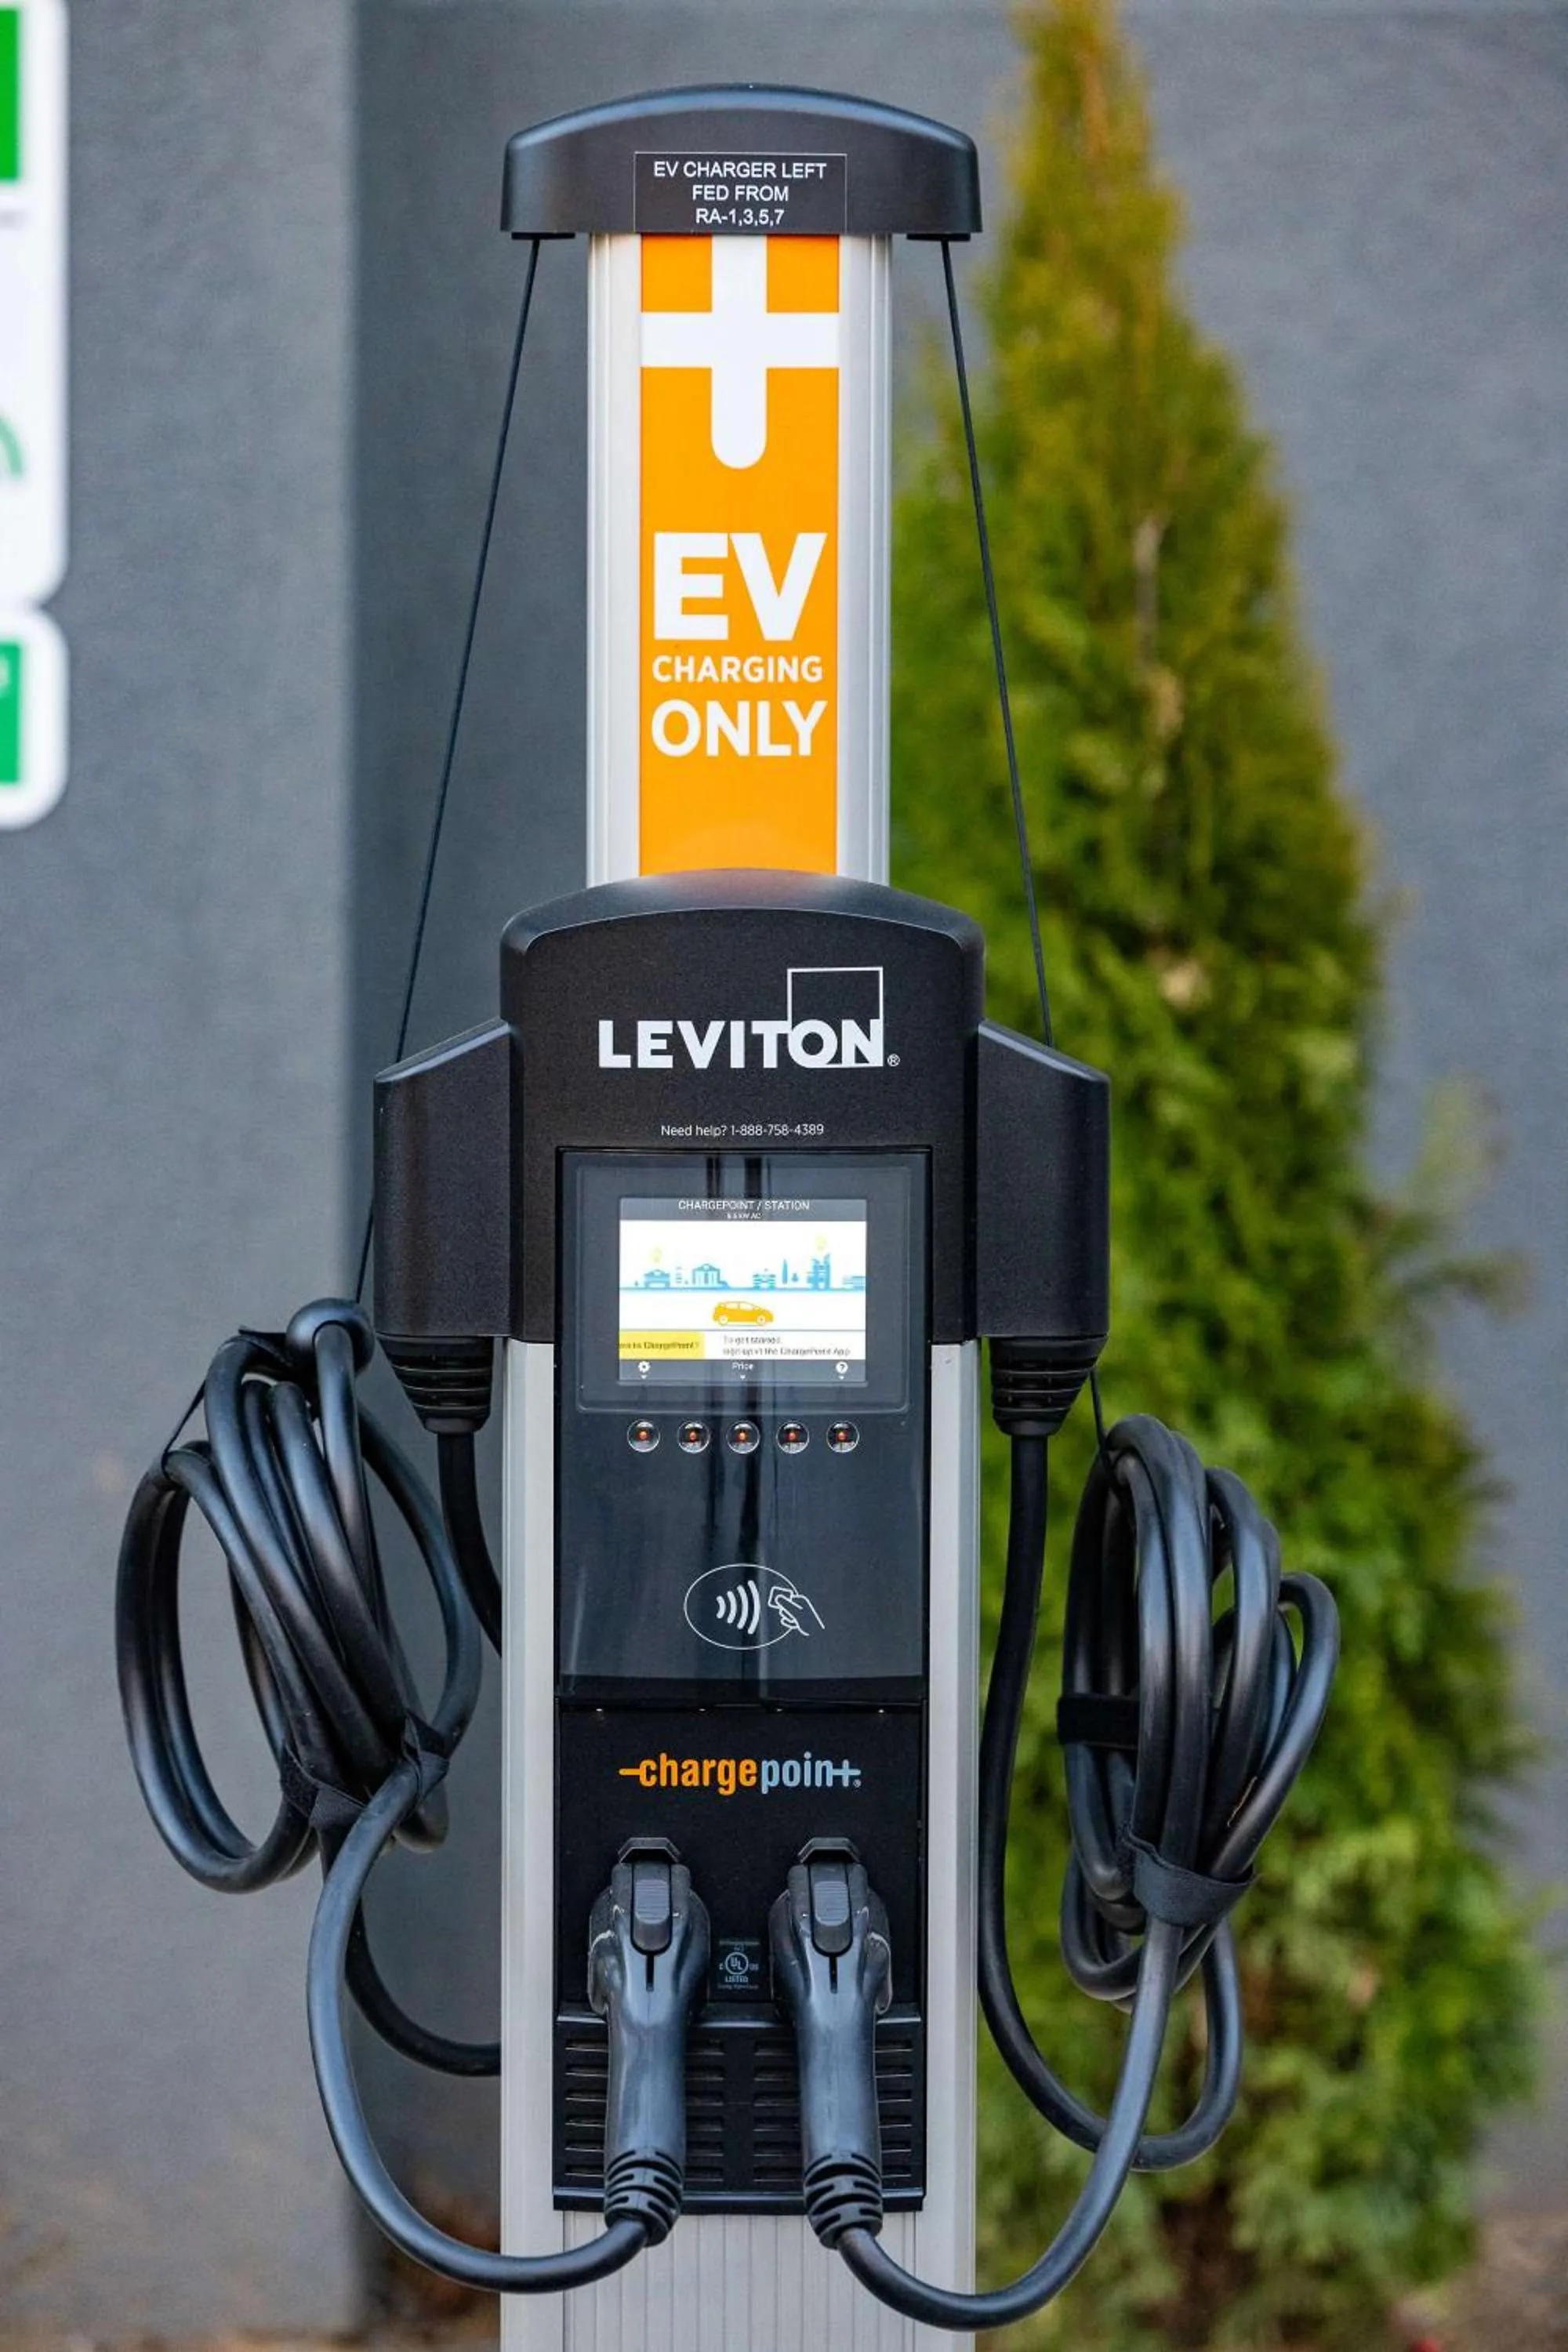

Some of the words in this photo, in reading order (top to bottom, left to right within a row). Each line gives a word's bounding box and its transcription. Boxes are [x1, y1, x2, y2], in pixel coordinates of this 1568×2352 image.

[653, 161, 679, 177] EV
[683, 161, 776, 179] CHARGER
[782, 162, 827, 179] LEFT
[691, 184, 729, 201] FED
[735, 185, 789, 201] FROM
[695, 208, 785, 226] RA-1,3,5,7
[654, 532, 828, 641] EV
[652, 655, 823, 684] CHARGING
[652, 699, 828, 757] ONLY
[660, 1124, 692, 1136] Need
[695, 1124, 728, 1138] help?
[731, 1123, 825, 1136] 1-888-758-4389
[678, 1200, 754, 1211] CHARGEPOINT
[764, 1200, 810, 1211] STATION
[731, 1362, 754, 1370] Price
